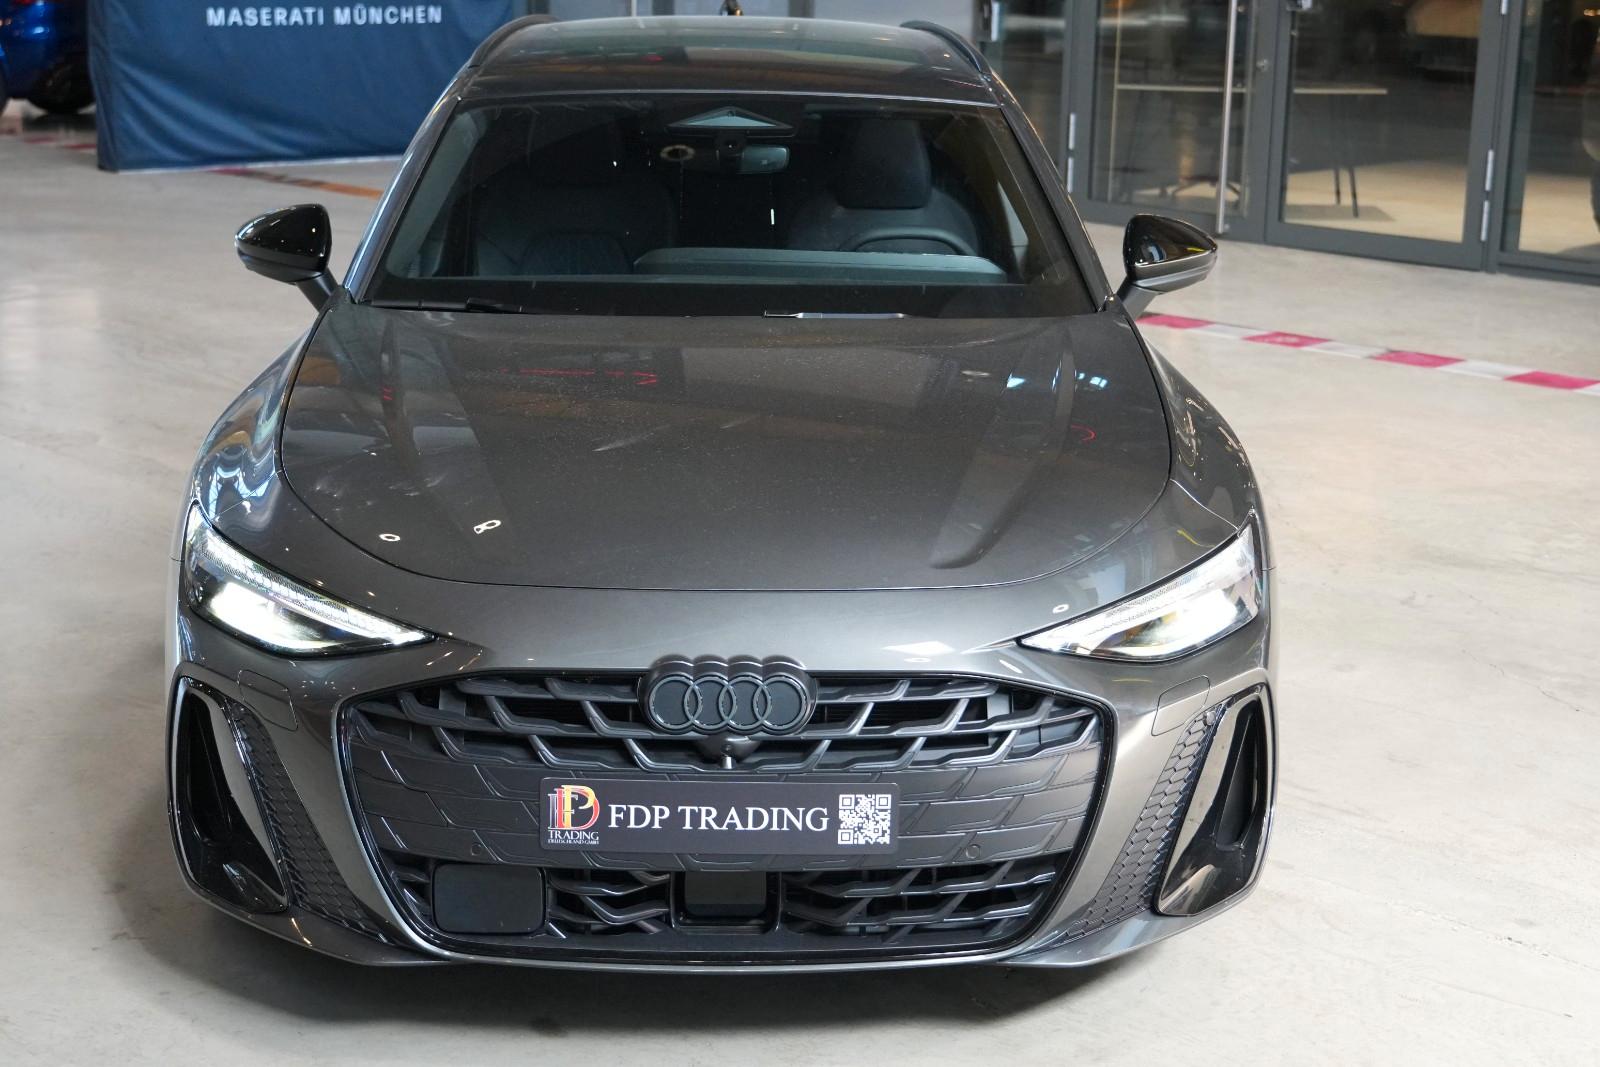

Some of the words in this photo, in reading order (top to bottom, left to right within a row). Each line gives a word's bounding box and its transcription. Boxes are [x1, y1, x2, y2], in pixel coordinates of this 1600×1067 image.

[206, 7, 324, 26] MASERATI
[333, 4, 442, 24] MÜNCHEN
[608, 804, 670, 829] FDP
[677, 806, 830, 832] TRADING
[548, 830, 599, 841] TRADING
